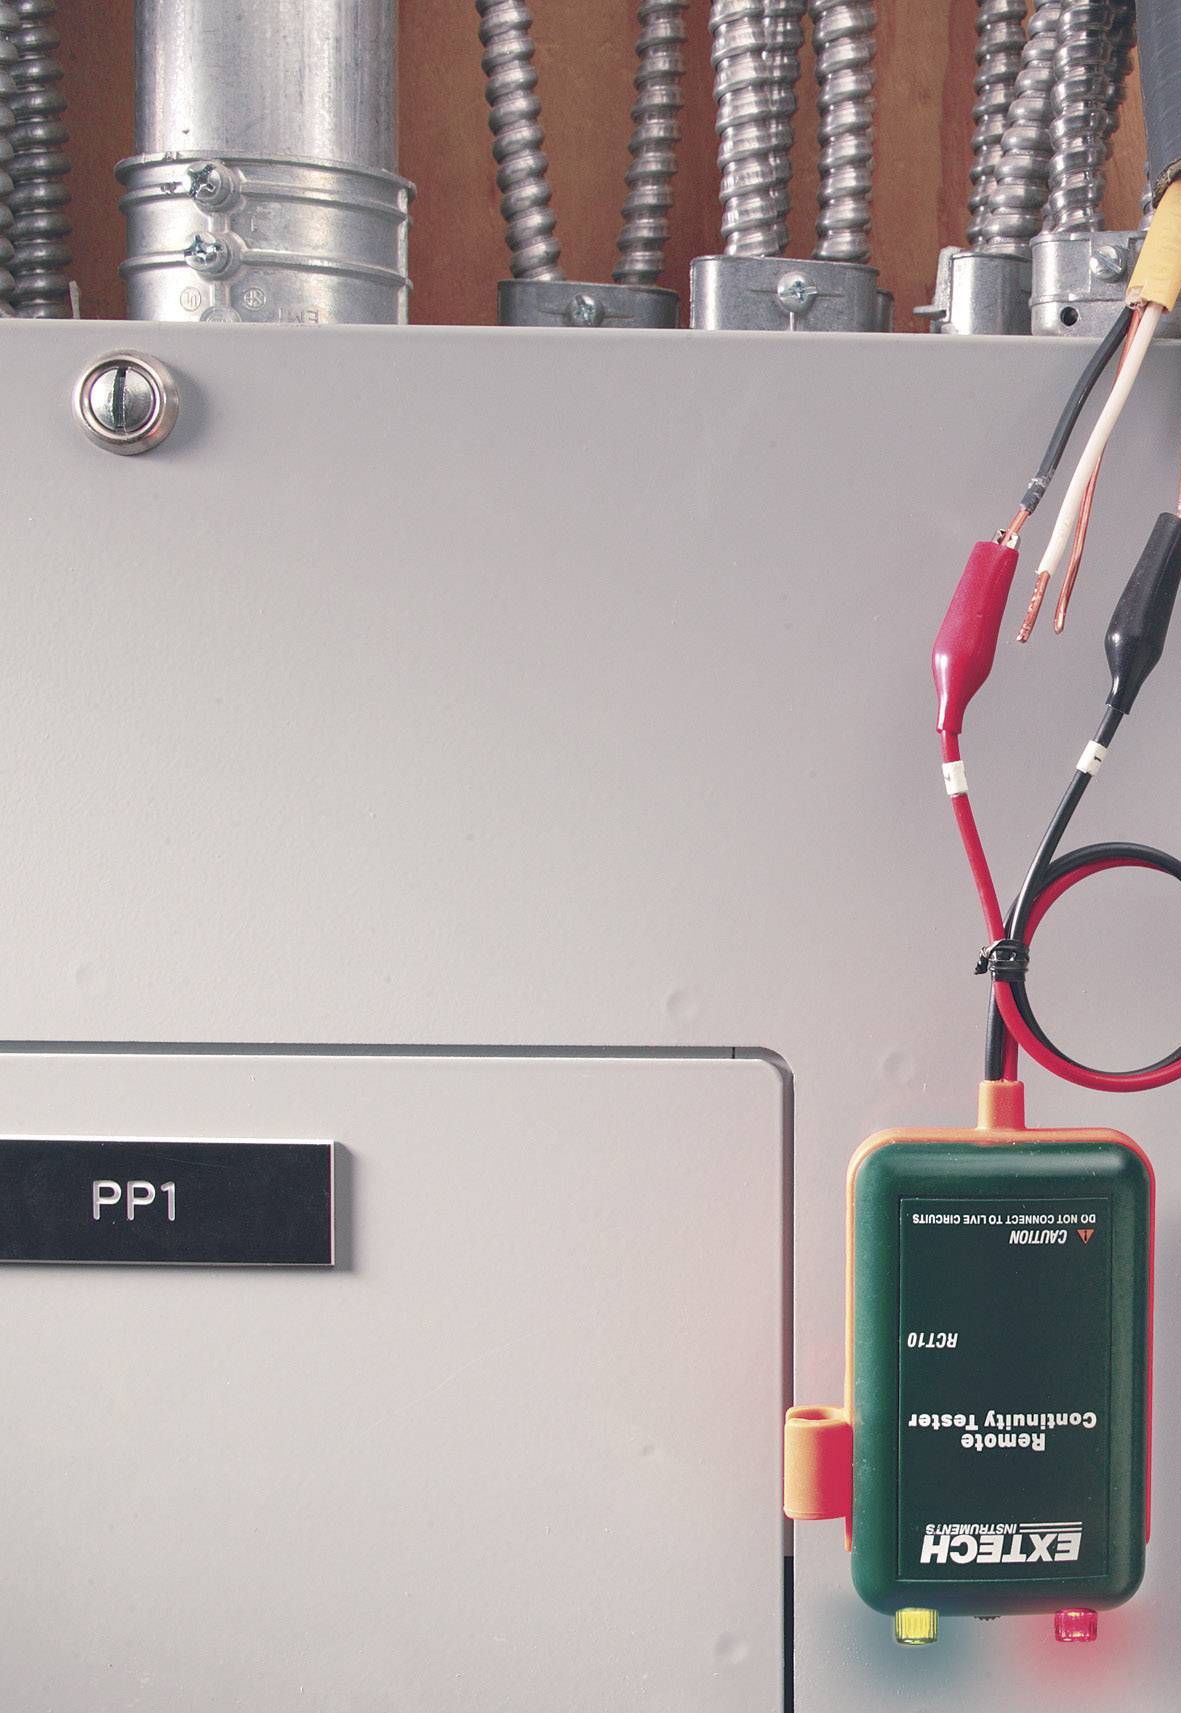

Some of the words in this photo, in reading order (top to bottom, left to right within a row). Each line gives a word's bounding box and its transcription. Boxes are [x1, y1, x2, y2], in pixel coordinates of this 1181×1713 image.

[93, 1180, 176, 1221] PP1
[913, 1213, 961, 1224] CIRCUITS
[963, 1214, 987, 1224] LIVE
[989, 1214, 1003, 1224] TO
[1005, 1214, 1055, 1224] CONNECT
[1057, 1214, 1078, 1224] NOT
[1080, 1214, 1096, 1224] DO
[1009, 1229, 1068, 1244] CAUTION
[907, 1332, 959, 1349] RCT10
[908, 1413, 978, 1431] Tester
[983, 1410, 1097, 1431] Continuity
[961, 1433, 1046, 1451] Remote
[925, 1523, 1018, 1535] INSTRUMENTS
[920, 1532, 1083, 1564] EXTECH
